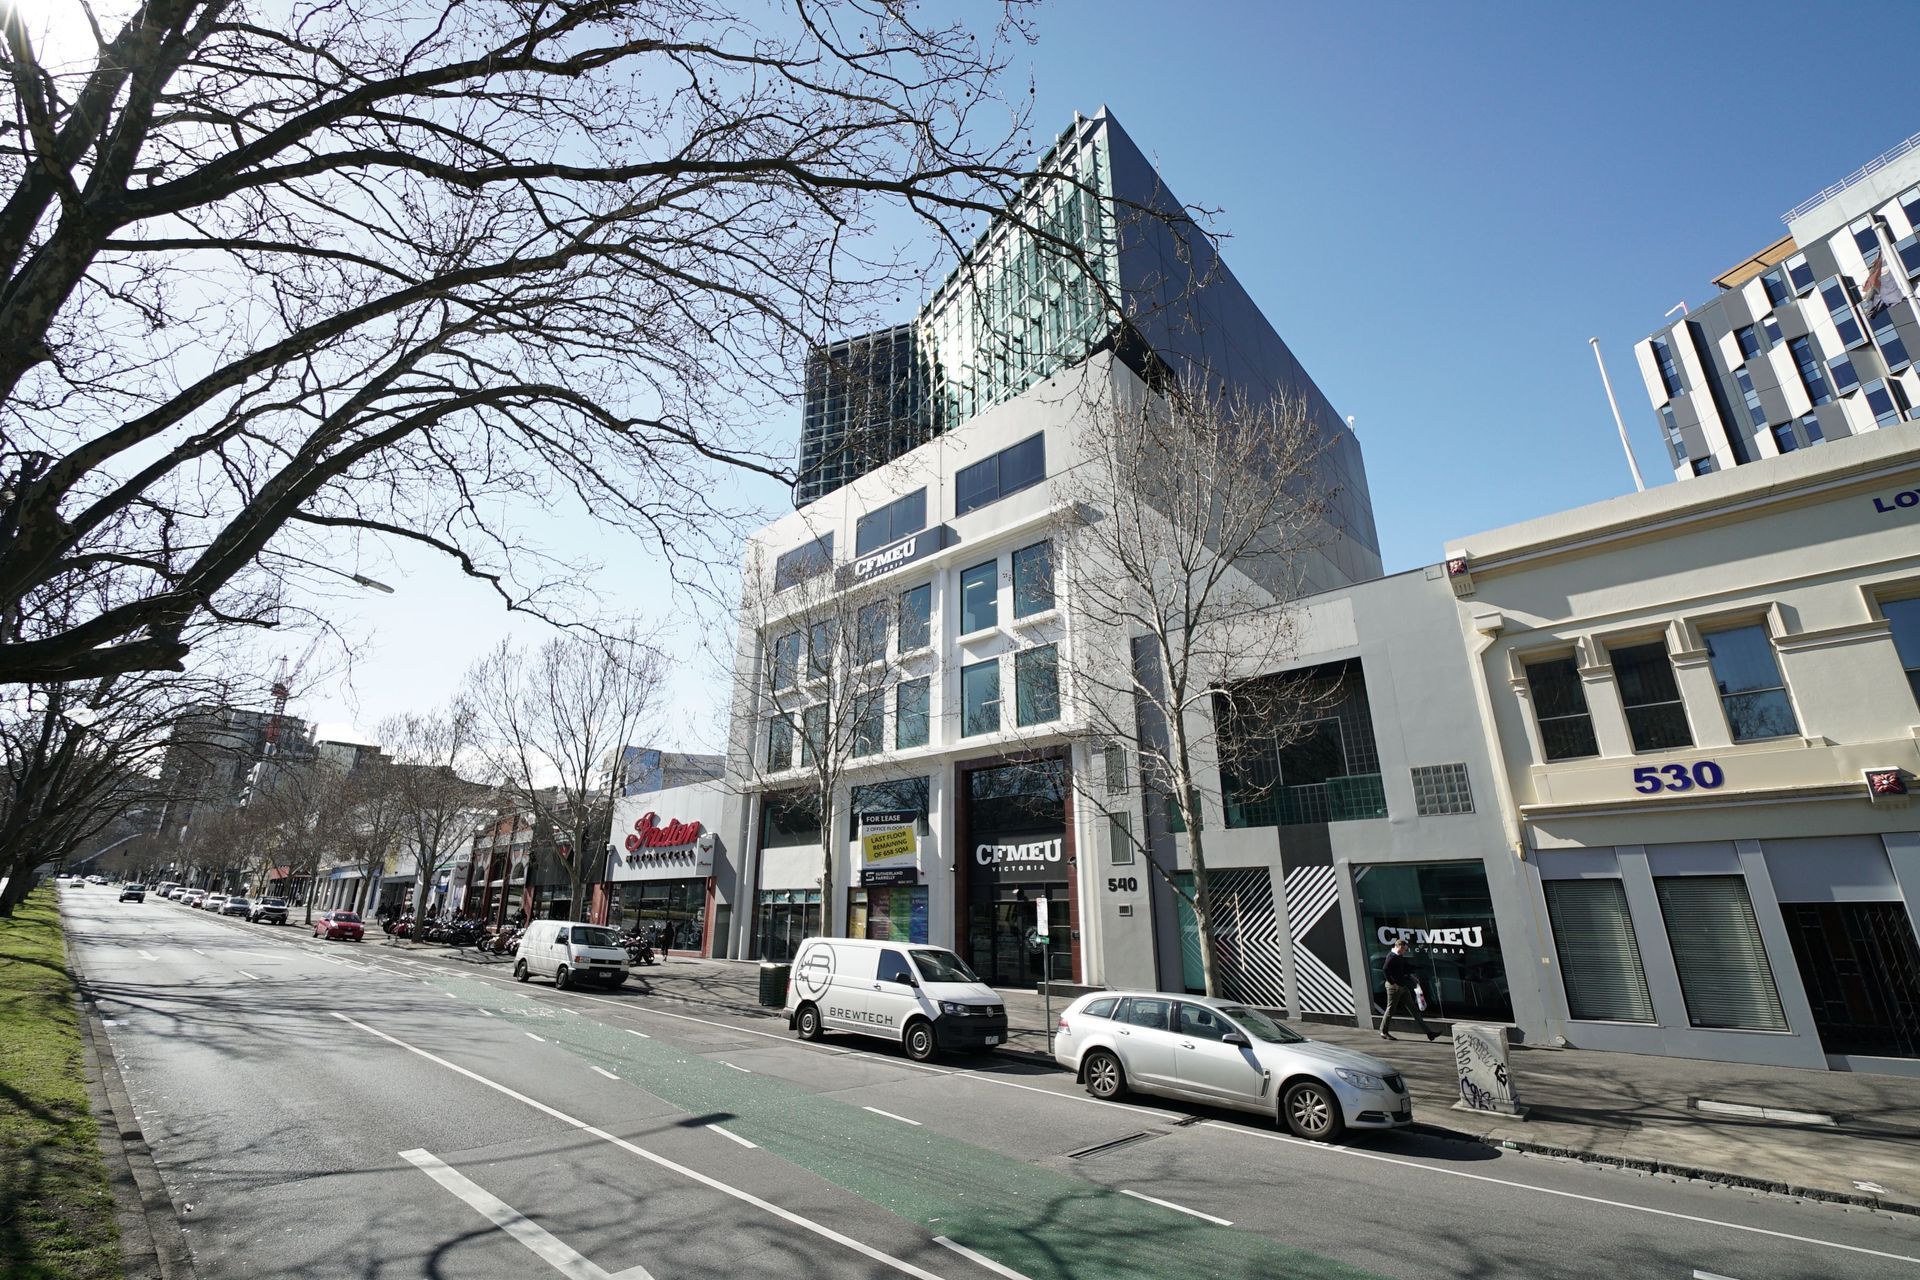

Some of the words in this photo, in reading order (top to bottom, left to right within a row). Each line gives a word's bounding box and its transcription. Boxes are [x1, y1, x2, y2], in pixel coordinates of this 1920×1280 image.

[855, 537, 916, 576] CFMEU
[1633, 761, 1725, 794] 530
[625, 812, 700, 852] Indian
[871, 835, 885, 843] LAST
[886, 831, 906, 840] FLOOR
[873, 839, 908, 850] REMAINING
[976, 838, 1062, 865] CFMEU
[991, 864, 1045, 873] VICTORIA
[1108, 876, 1138, 892] 540
[1377, 926, 1483, 948] CFMEU
[829, 1006, 893, 1025] BREWTECH
